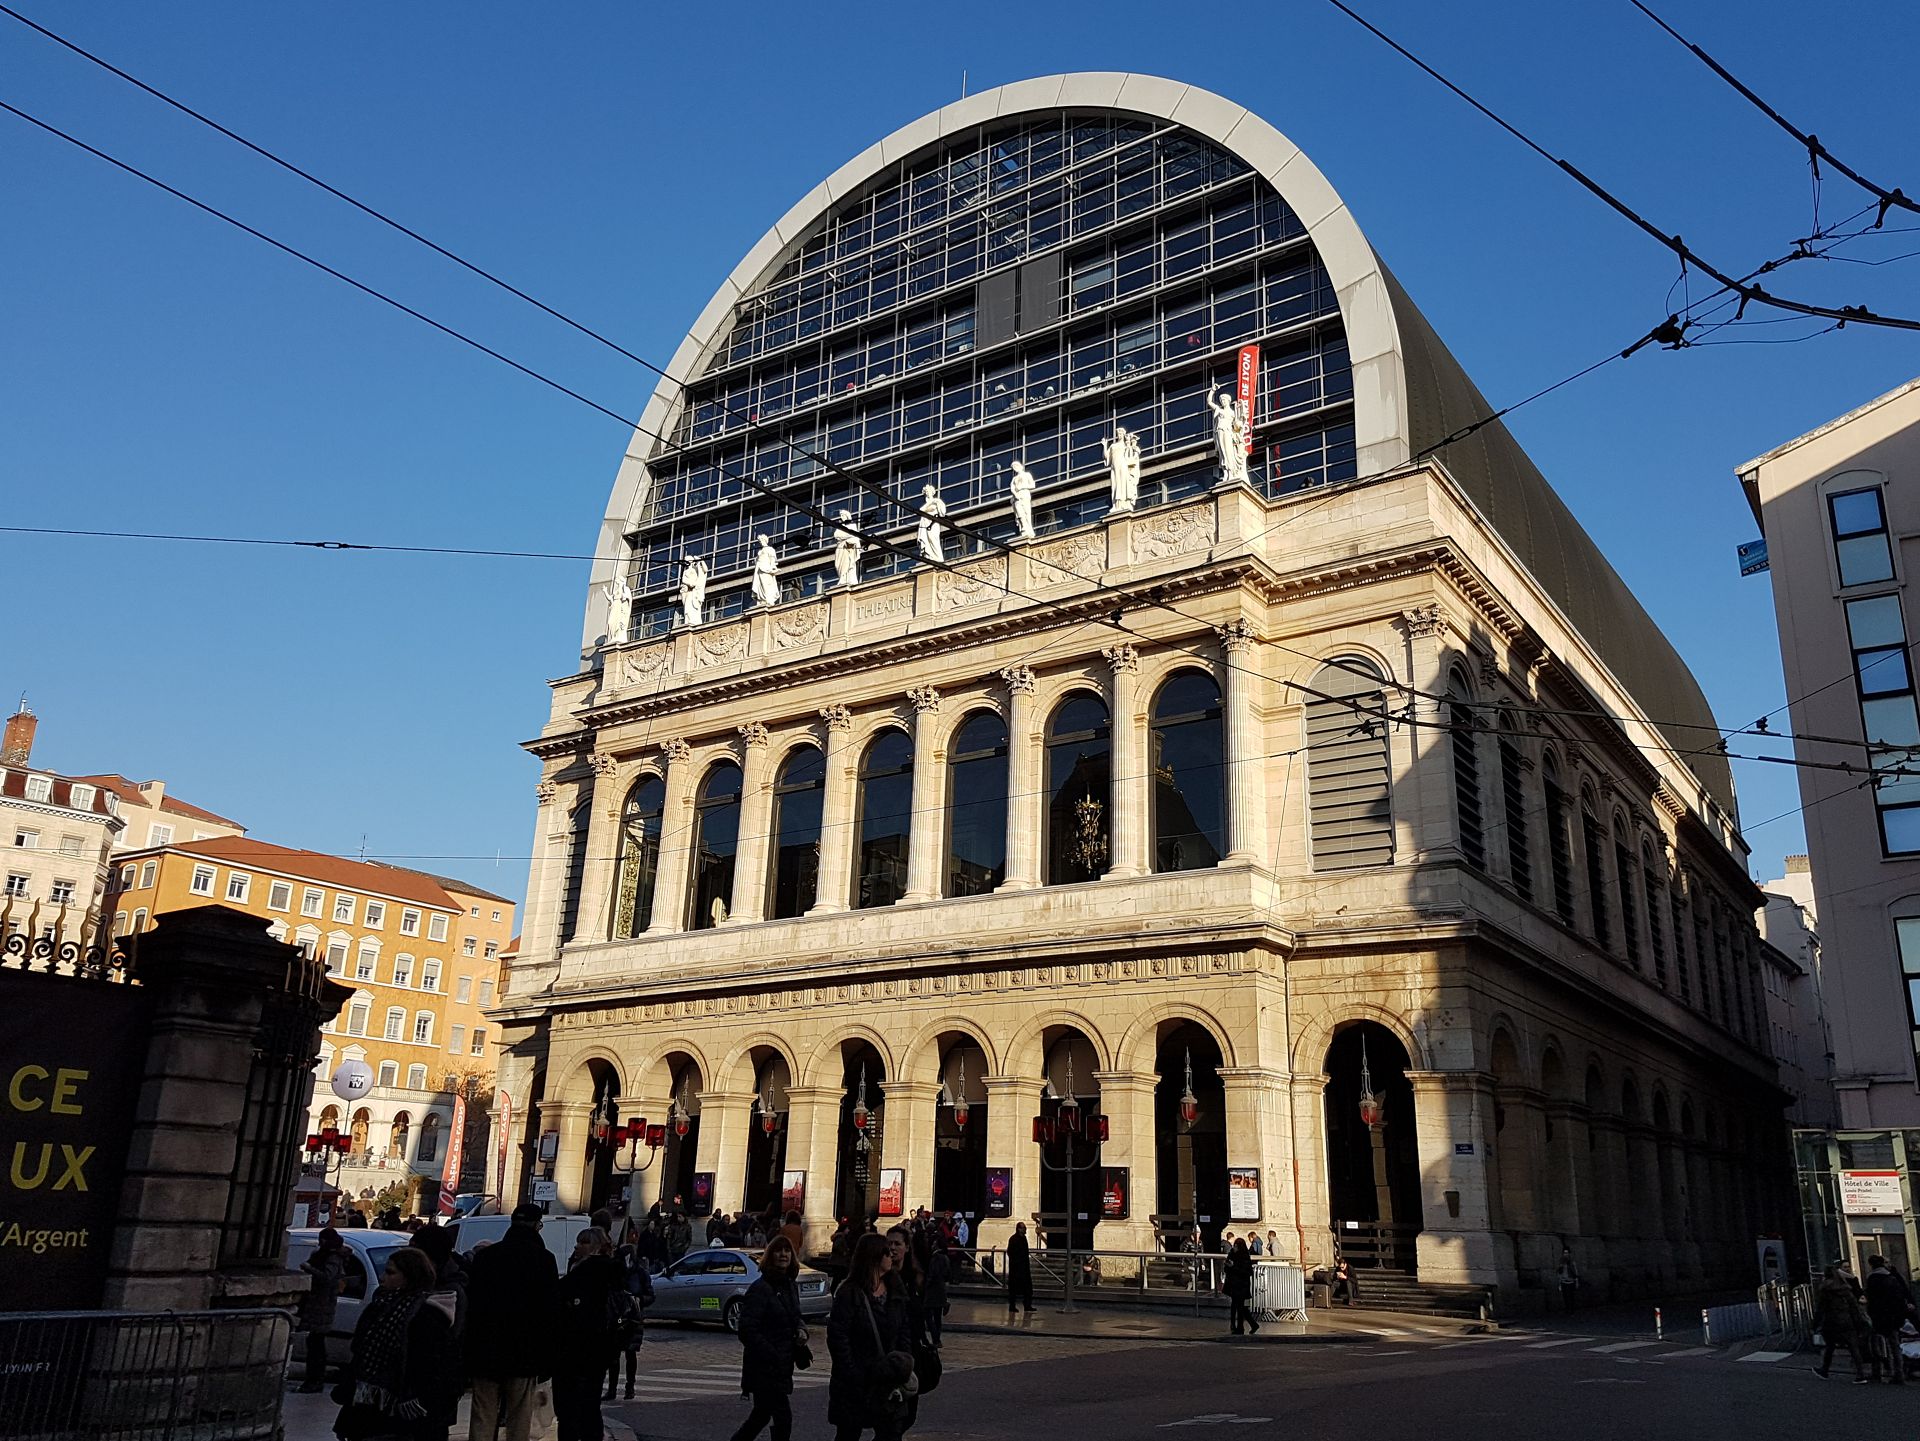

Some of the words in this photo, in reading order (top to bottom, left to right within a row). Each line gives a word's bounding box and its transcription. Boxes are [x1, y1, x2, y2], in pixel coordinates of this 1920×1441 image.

[1243, 353, 1252, 381] LYON
[1242, 383, 1249, 396] DE
[856, 594, 913, 619] THEATRE
[8, 1064, 89, 1115] CE
[10, 1141, 97, 1191] UX
